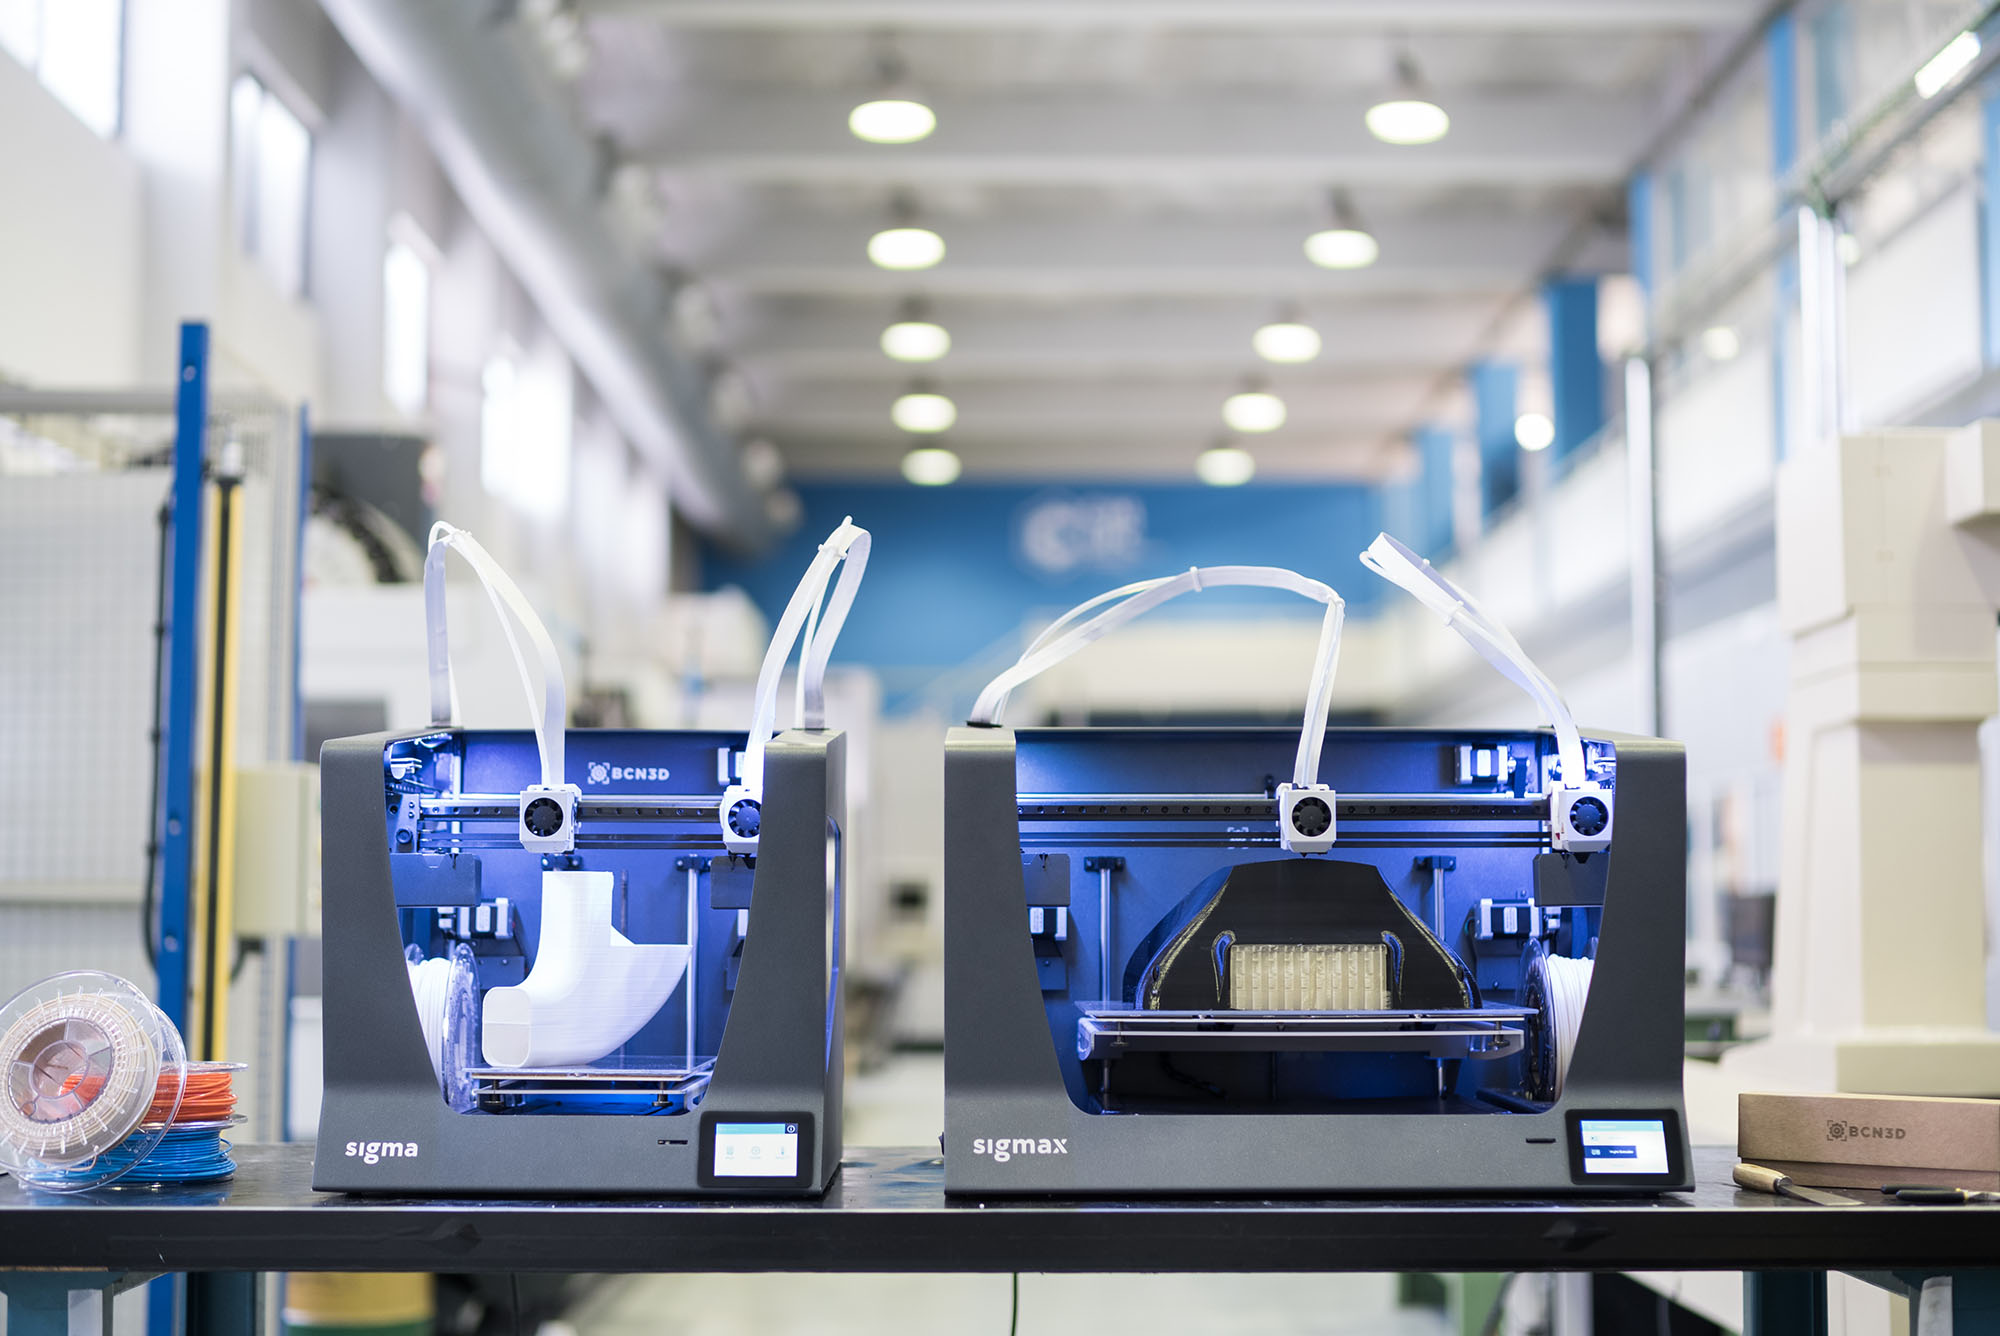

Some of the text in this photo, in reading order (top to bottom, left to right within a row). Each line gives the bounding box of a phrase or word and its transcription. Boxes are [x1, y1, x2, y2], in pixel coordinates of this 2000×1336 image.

[611, 767, 670, 781] BCN3D
[1848, 1126, 1906, 1140] BCN3D
[344, 1141, 419, 1165] sigma
[973, 1138, 1068, 1162] sigmax
